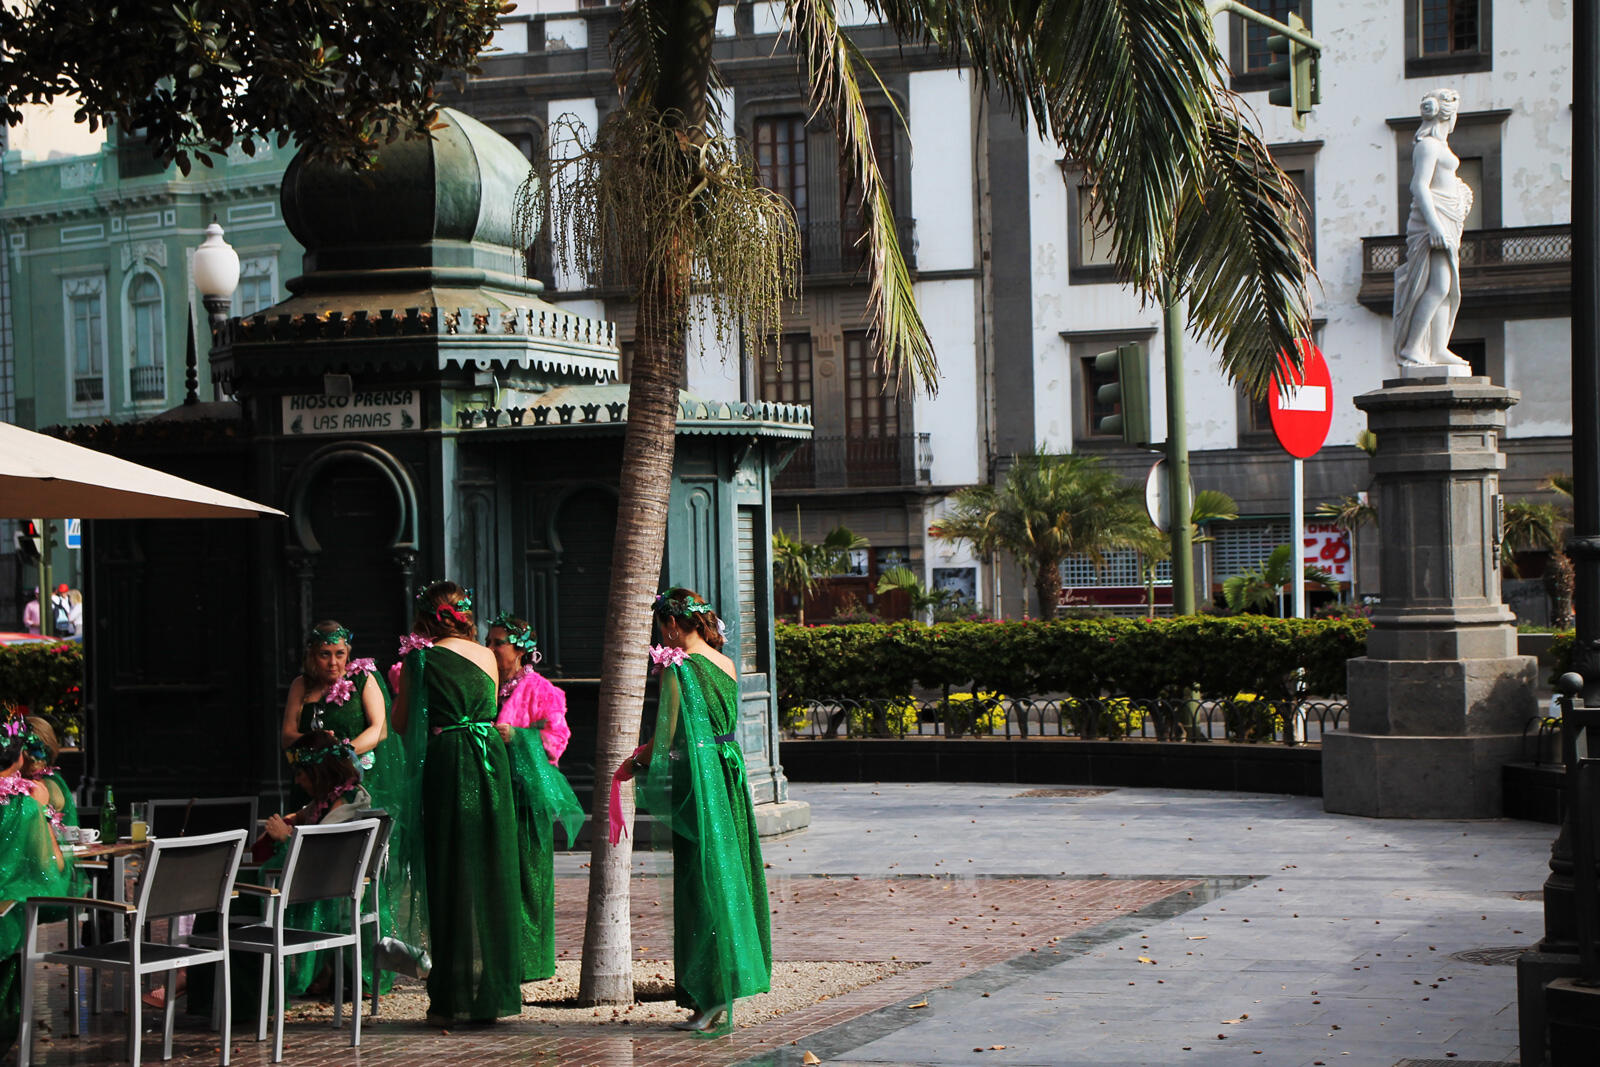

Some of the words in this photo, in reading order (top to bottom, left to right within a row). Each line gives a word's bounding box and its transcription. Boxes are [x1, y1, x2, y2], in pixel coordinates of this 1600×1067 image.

[290, 394, 349, 410] KIOSCO
[354, 391, 413, 407] PRENSA
[313, 415, 338, 430] LAS
[343, 412, 392, 429] RANAS
